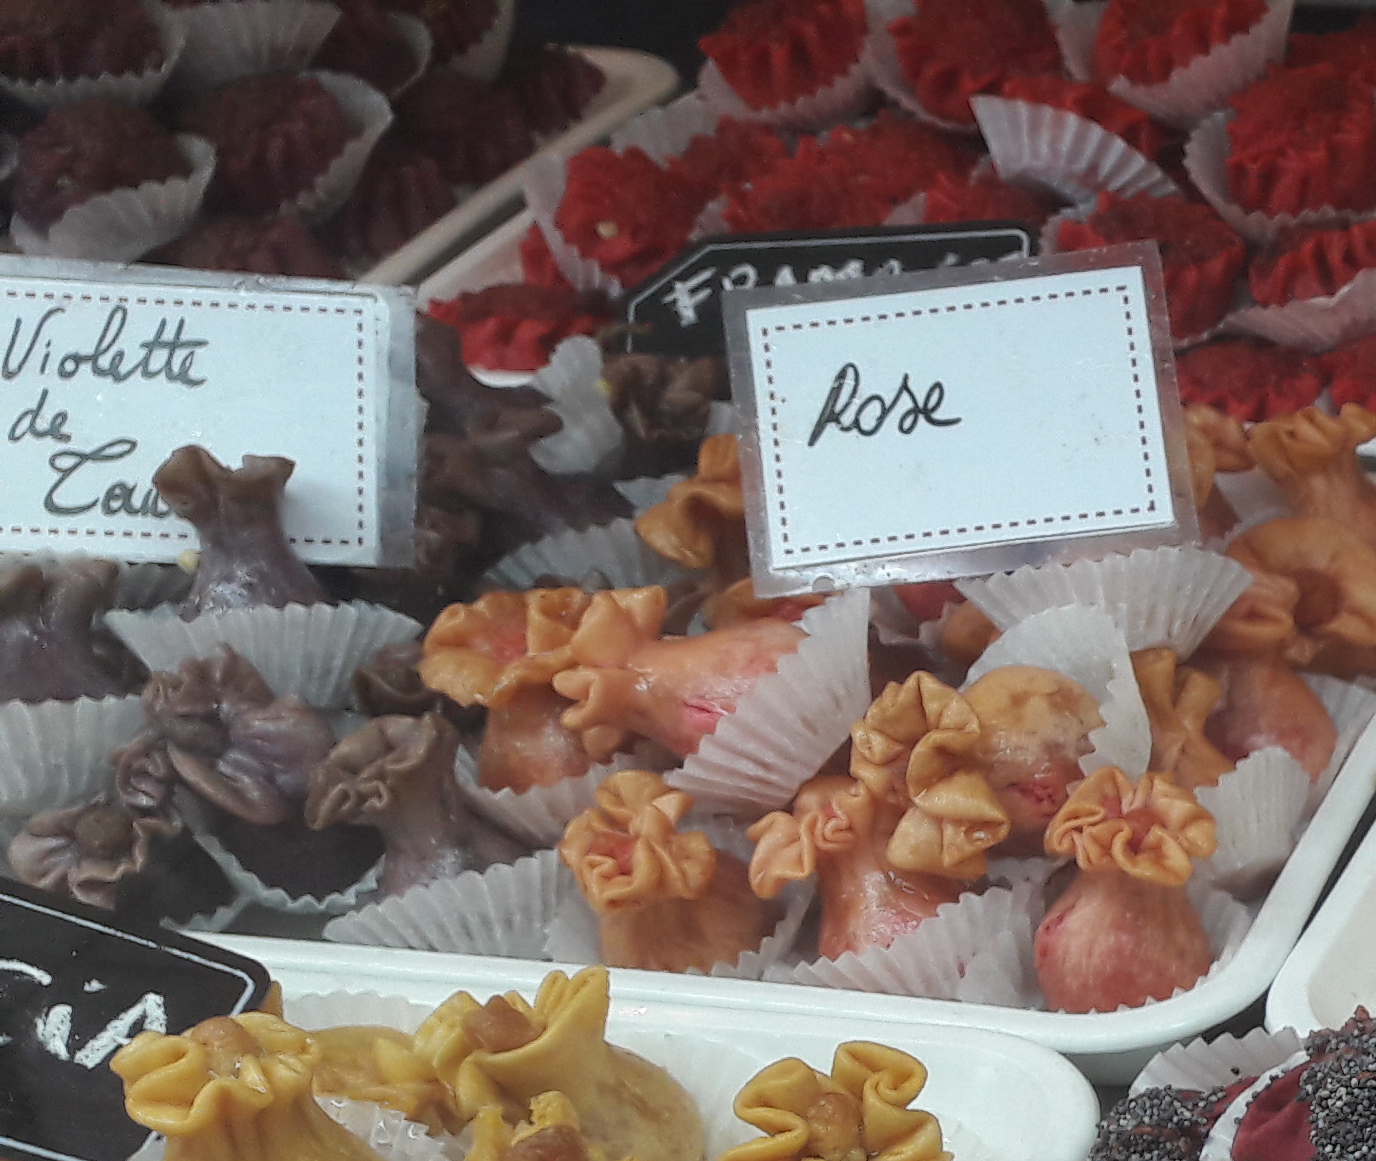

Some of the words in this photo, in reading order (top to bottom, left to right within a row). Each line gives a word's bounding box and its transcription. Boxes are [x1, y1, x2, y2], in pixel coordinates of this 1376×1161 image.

[1, 304, 210, 388] Violette
[8, 388, 72, 443] de
[808, 362, 963, 448] Rose
